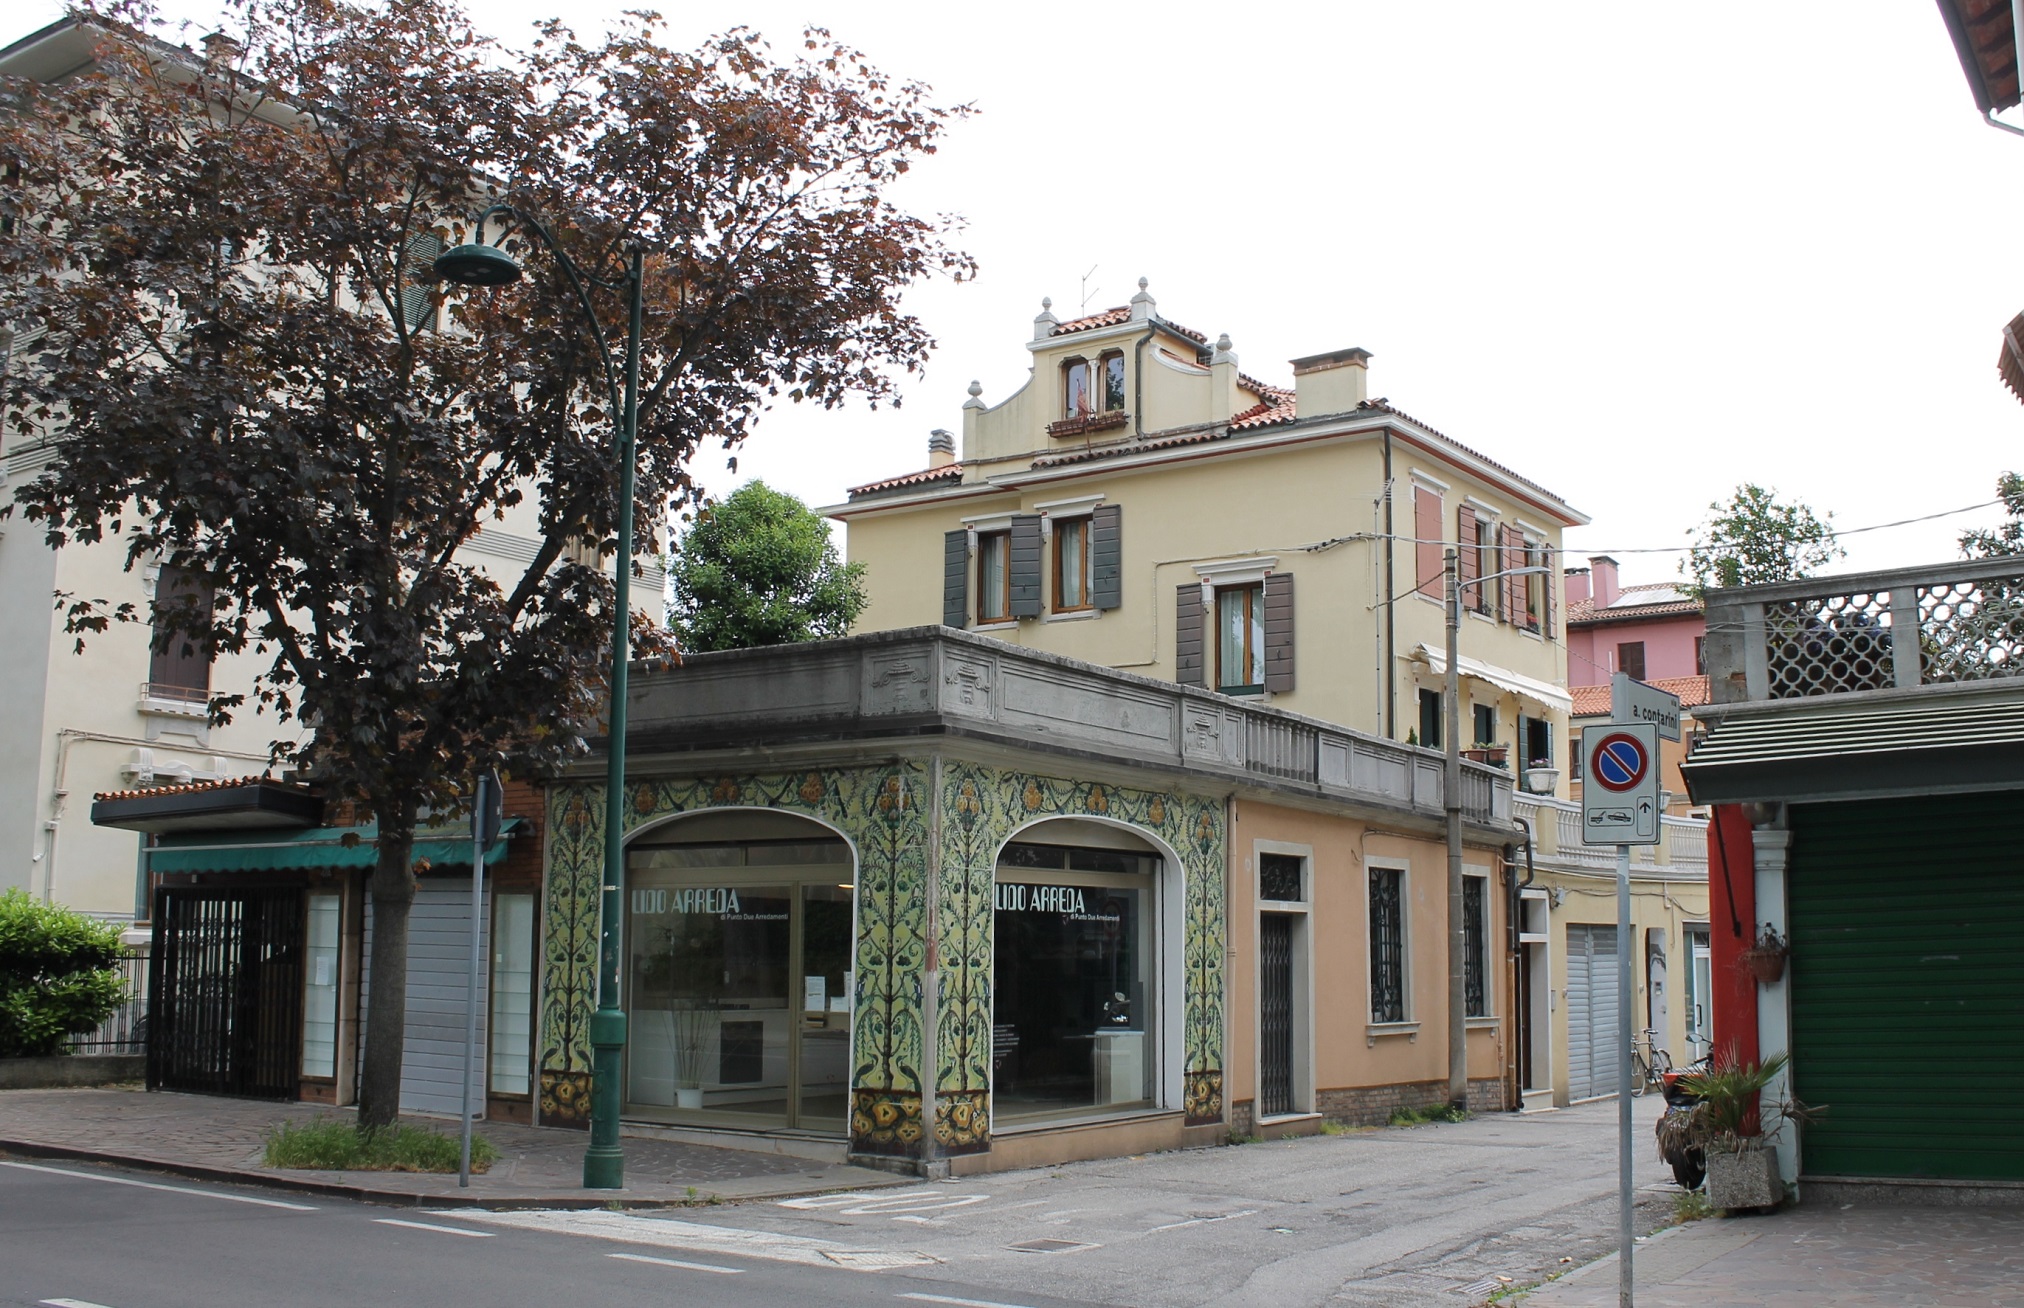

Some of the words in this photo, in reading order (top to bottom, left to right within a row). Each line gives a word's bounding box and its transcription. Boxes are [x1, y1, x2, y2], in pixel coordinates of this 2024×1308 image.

[1633, 704, 1641, 718] a.
[1642, 707, 1678, 730] contarini
[631, 889, 667, 914] LIDO
[670, 888, 740, 914] ARREDA
[994, 883, 1027, 911] LIDO
[1029, 885, 1085, 914] ARREDA
[726, 913, 743, 921] Punto
[743, 913, 754, 921] Due
[755, 912, 789, 920] Arredamenti
[1096, 914, 1120, 922] Arredamenti
